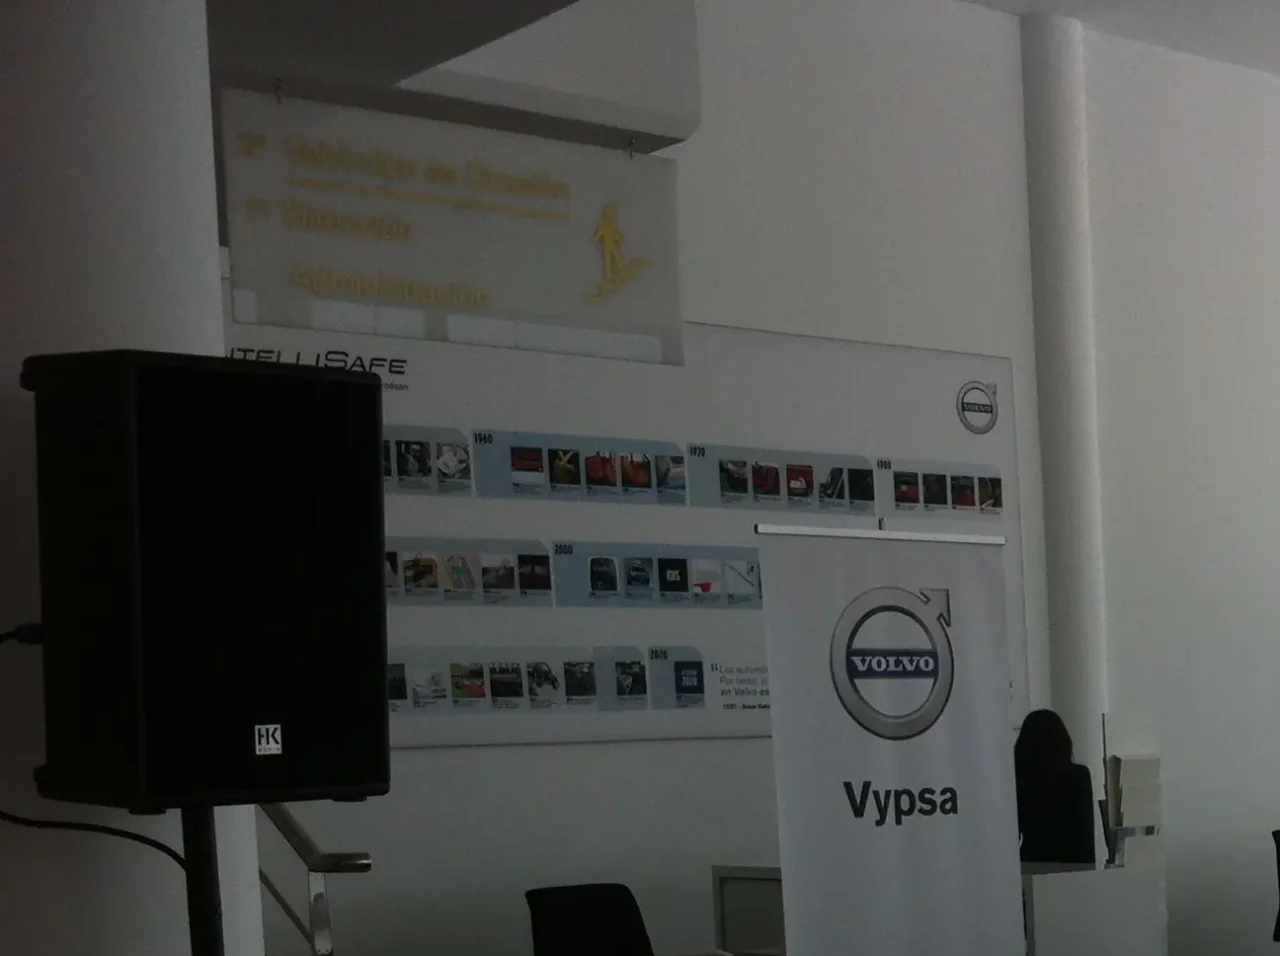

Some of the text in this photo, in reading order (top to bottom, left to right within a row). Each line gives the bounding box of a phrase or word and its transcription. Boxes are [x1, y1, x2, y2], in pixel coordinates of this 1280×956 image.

[850, 656, 935, 672] VOLVO
[258, 727, 280, 745] HK
[843, 780, 959, 827] Vypsa
